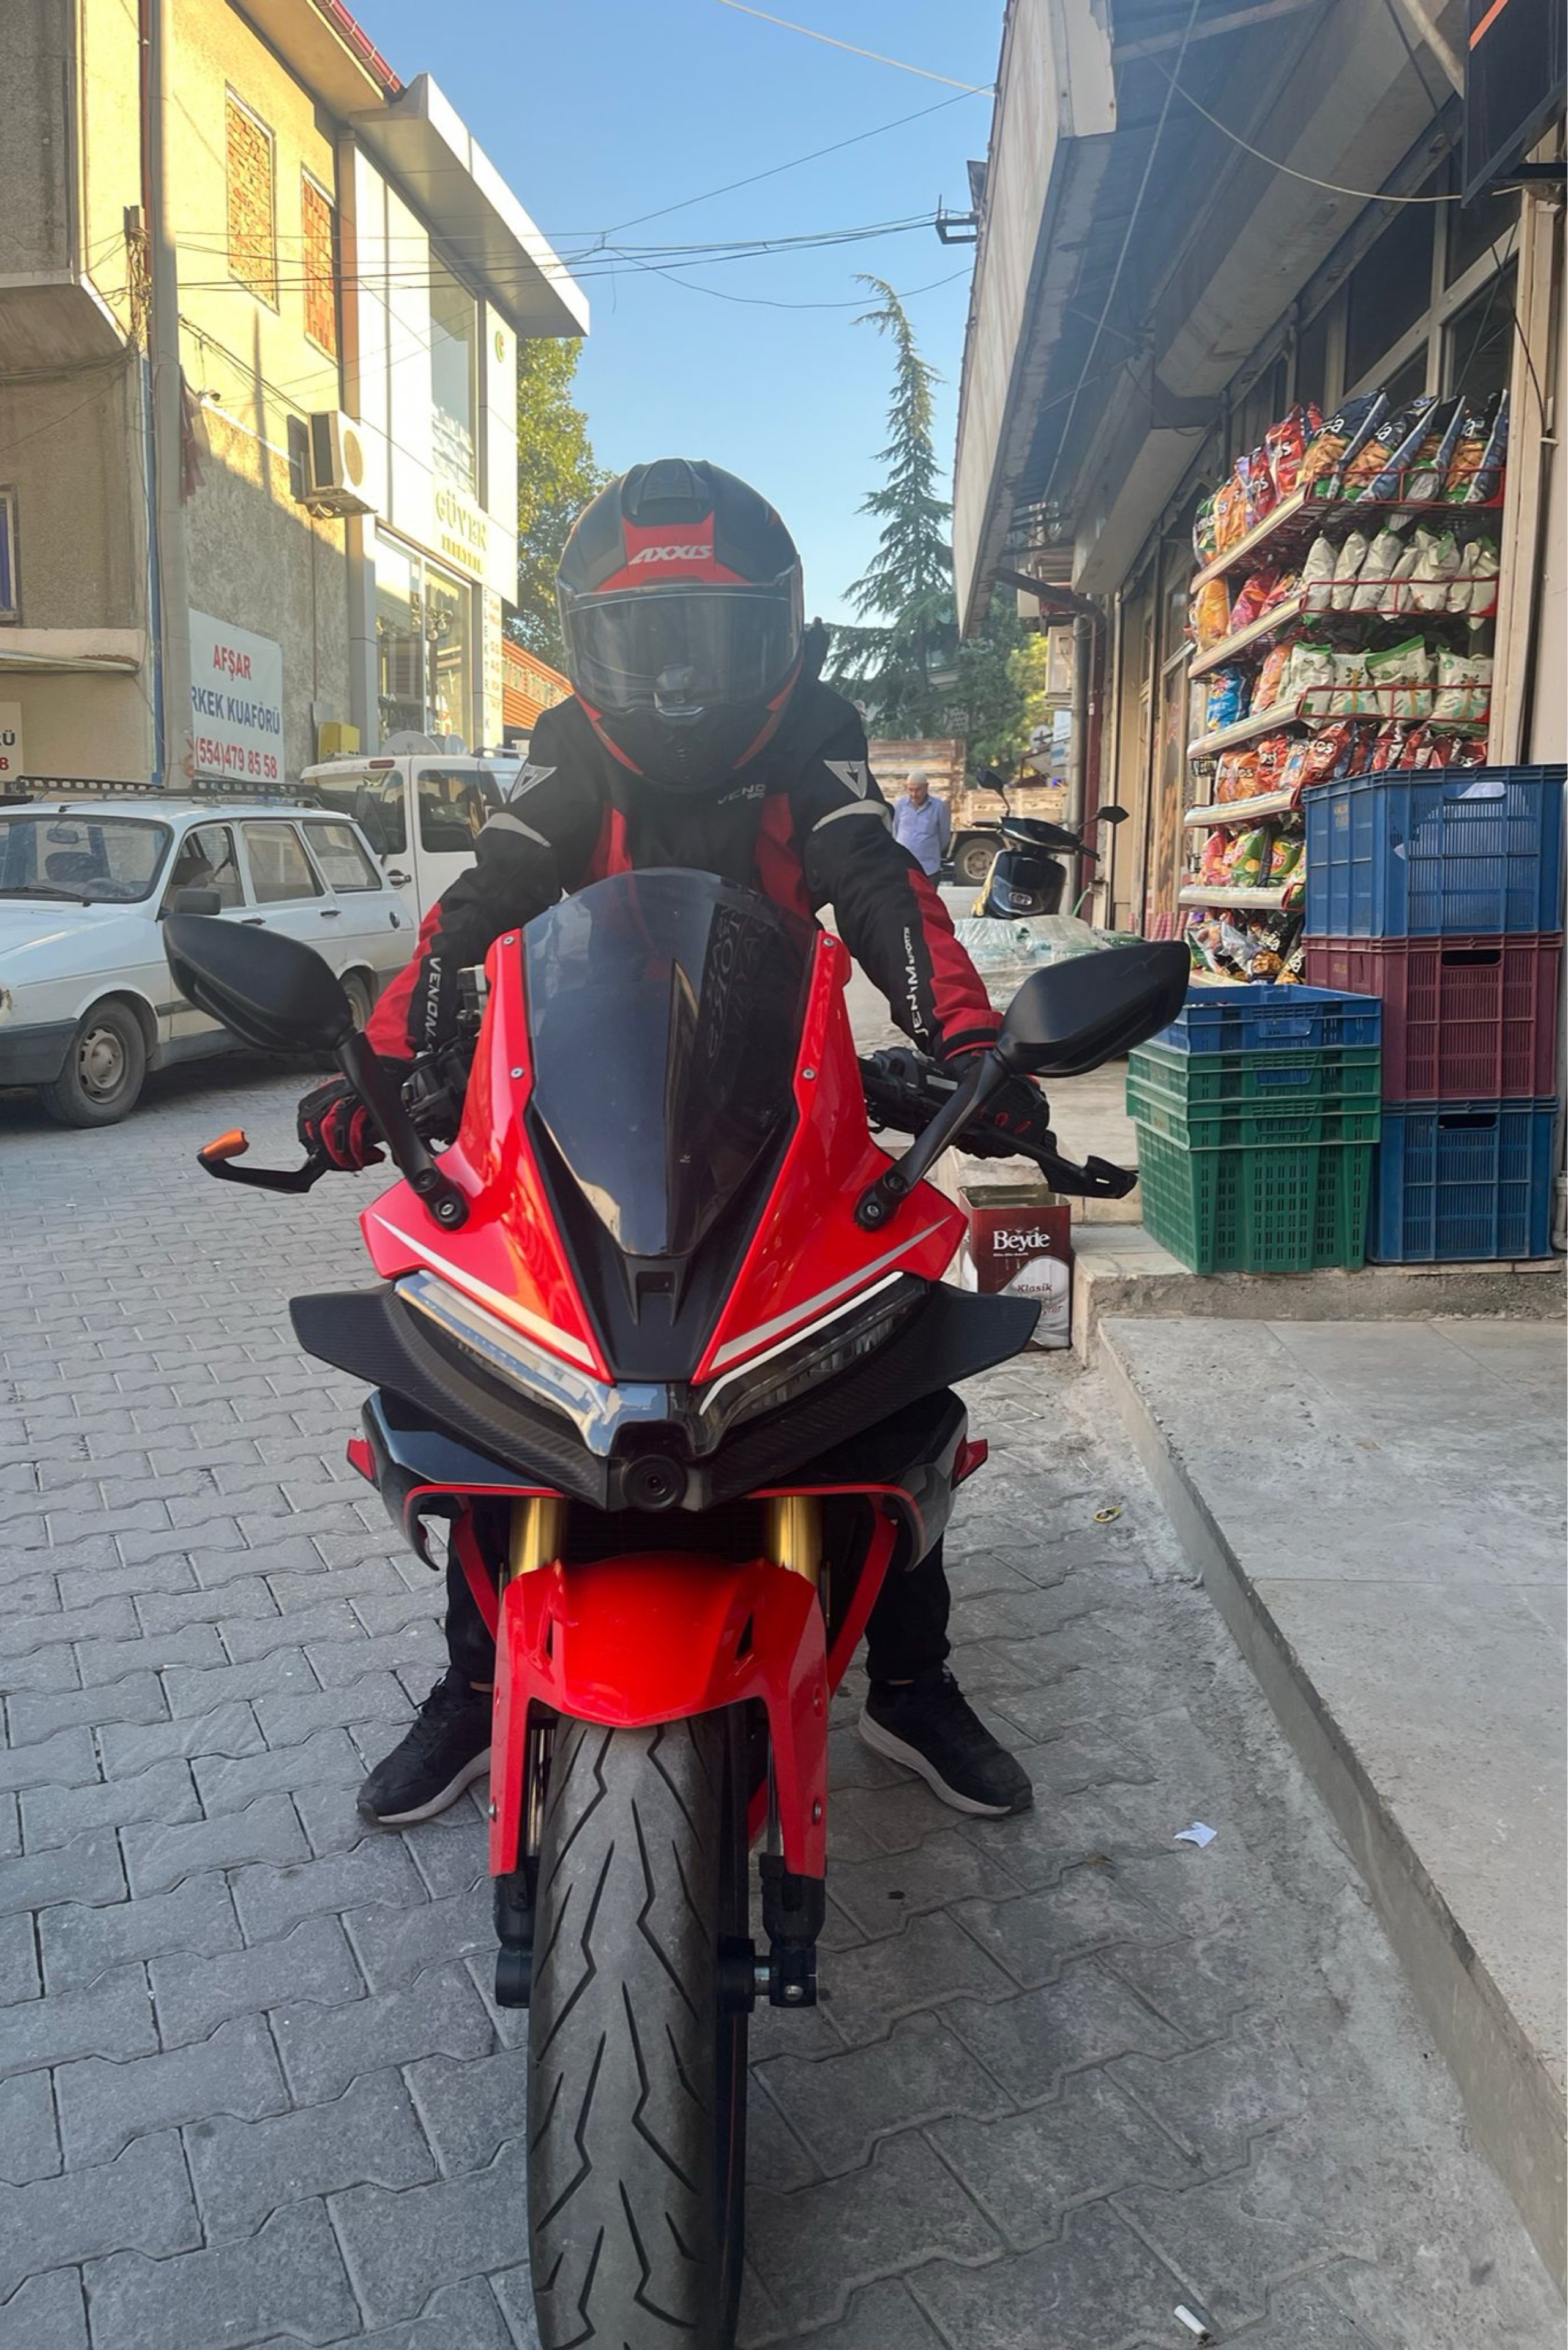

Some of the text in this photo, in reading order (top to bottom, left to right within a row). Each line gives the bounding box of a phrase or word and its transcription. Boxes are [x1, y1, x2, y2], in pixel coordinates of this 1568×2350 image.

[627, 545, 713, 565] AXXIS
[213, 644, 252, 681] AFŞAR
[226, 696, 280, 735] KUAFÖRÜ
[195, 736, 278, 780] (554)479 85 58
[1017, 1282, 1053, 1292] Klasik
